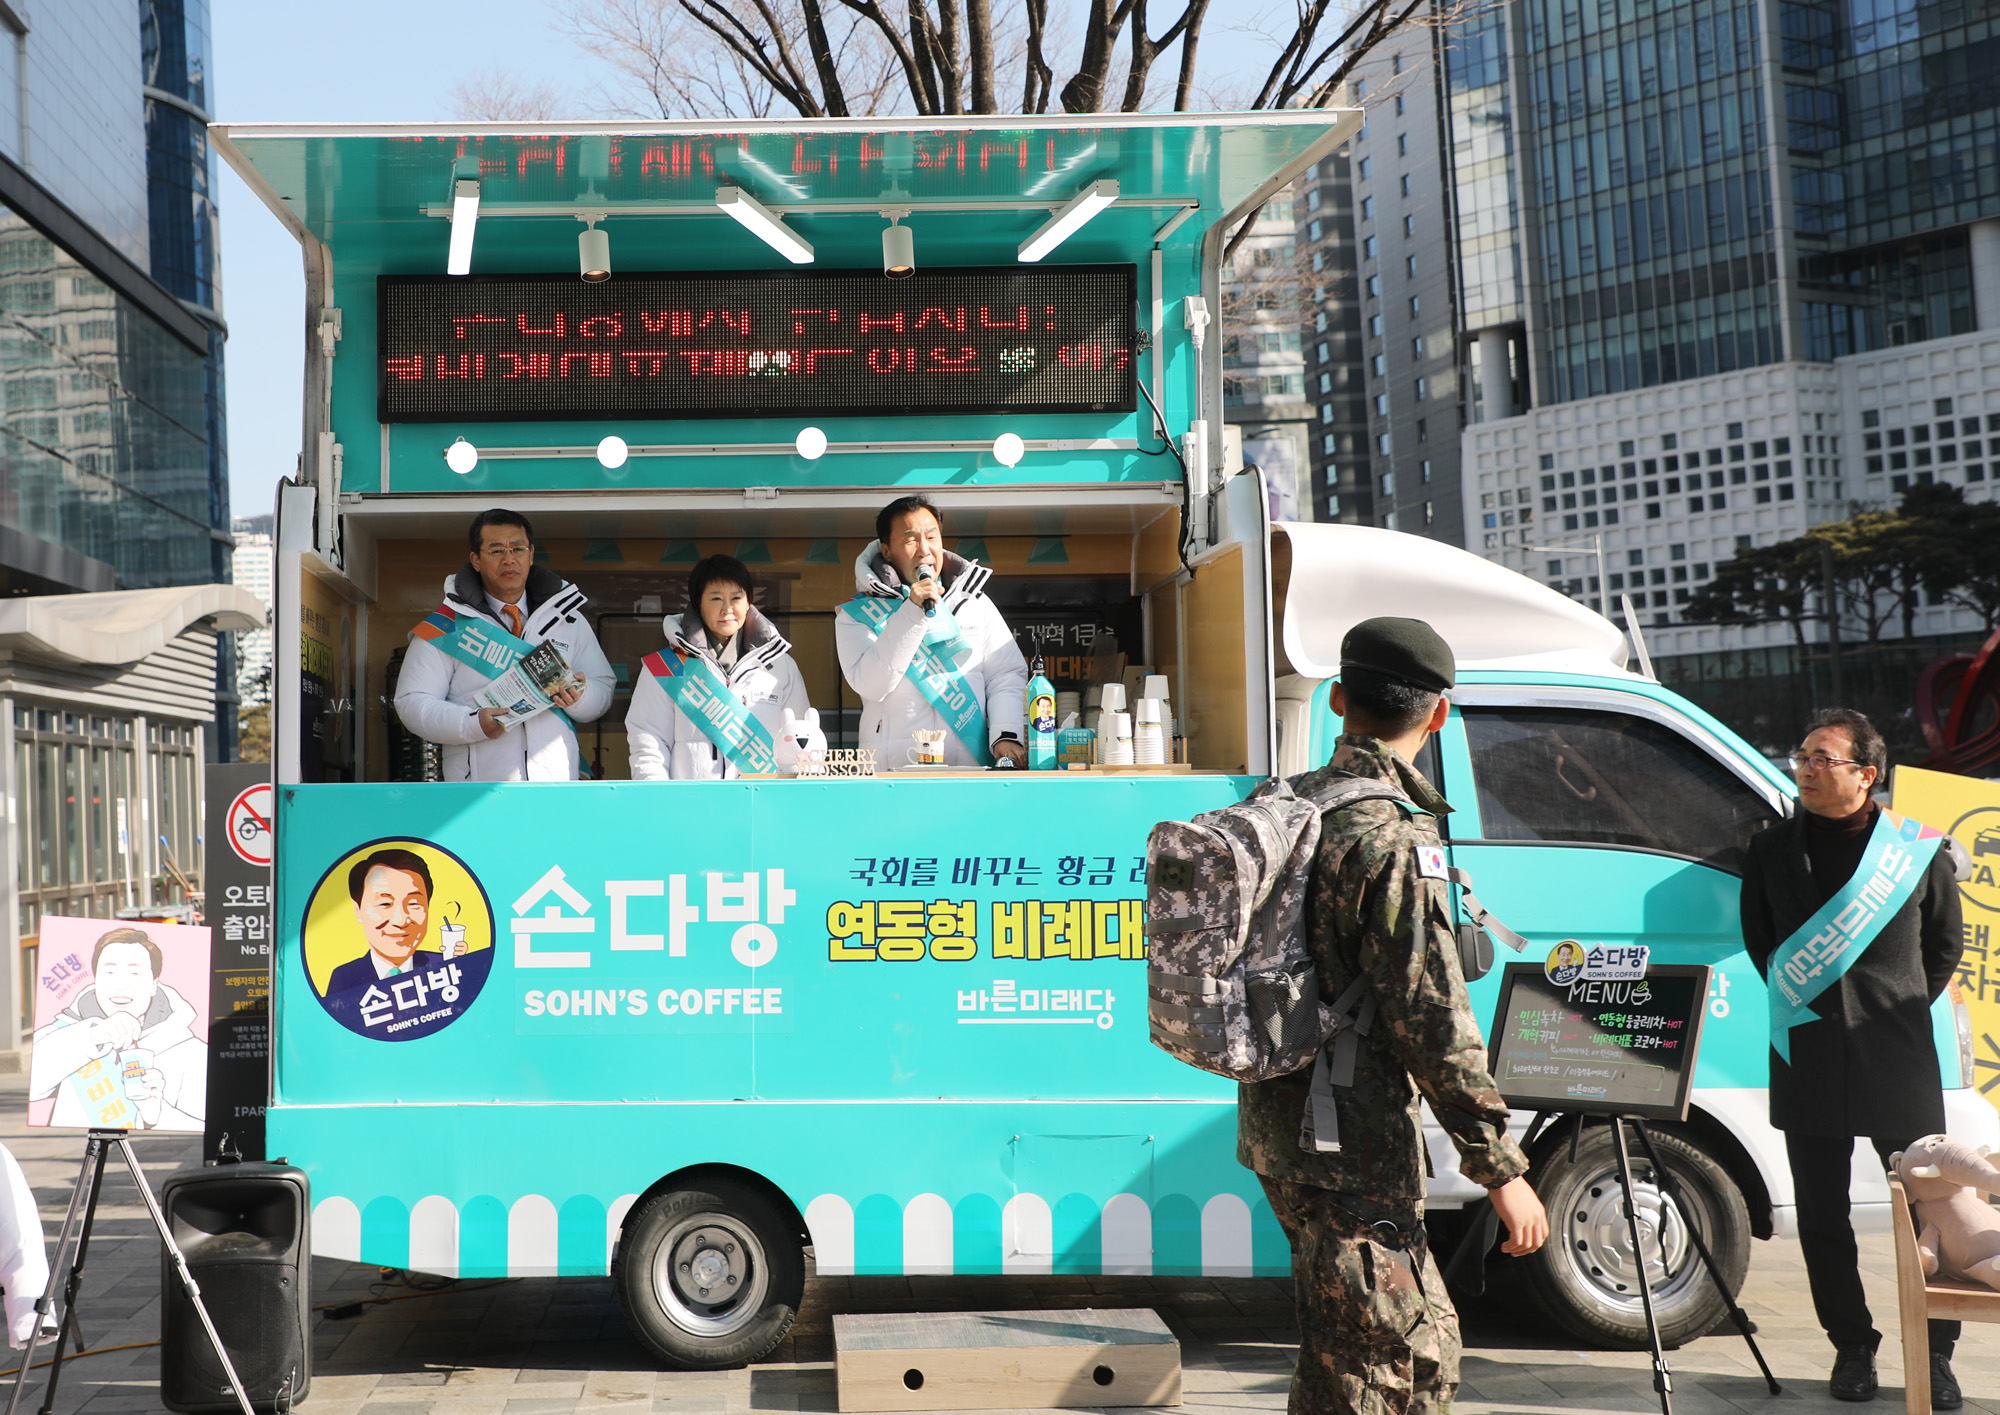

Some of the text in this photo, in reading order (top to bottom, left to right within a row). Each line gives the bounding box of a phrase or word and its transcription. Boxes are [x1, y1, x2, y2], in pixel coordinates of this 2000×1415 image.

[810, 749, 877, 762] CHERRY
[849, 857, 939, 886] 국회를
[951, 857, 1043, 886] 바꾸는
[1056, 855, 1116, 886] 황금
[223, 885, 270, 907] 오토
[510, 864, 797, 968] 손다방
[1784, 842, 1913, 986] 바른미래당
[223, 914, 270, 941] 출입
[827, 899, 1149, 961] 연동형 비례대
[241, 945, 257, 955] No
[1587, 947, 1647, 968] 손다방
[42, 953, 83, 992] 손다방
[359, 963, 463, 1028] 손다방
[657, 988, 782, 1015] COFFEE
[1568, 982, 1631, 1003] MENU
[420, 1007, 453, 1024] COFFEE
[957, 980, 1115, 1030] 바른미래당
[1519, 1010, 1565, 1027] 민심녹차
[1667, 1020, 1683, 1029] HOT
[1592, 1033, 1679, 1049] 비례대표 코코아 HOT
